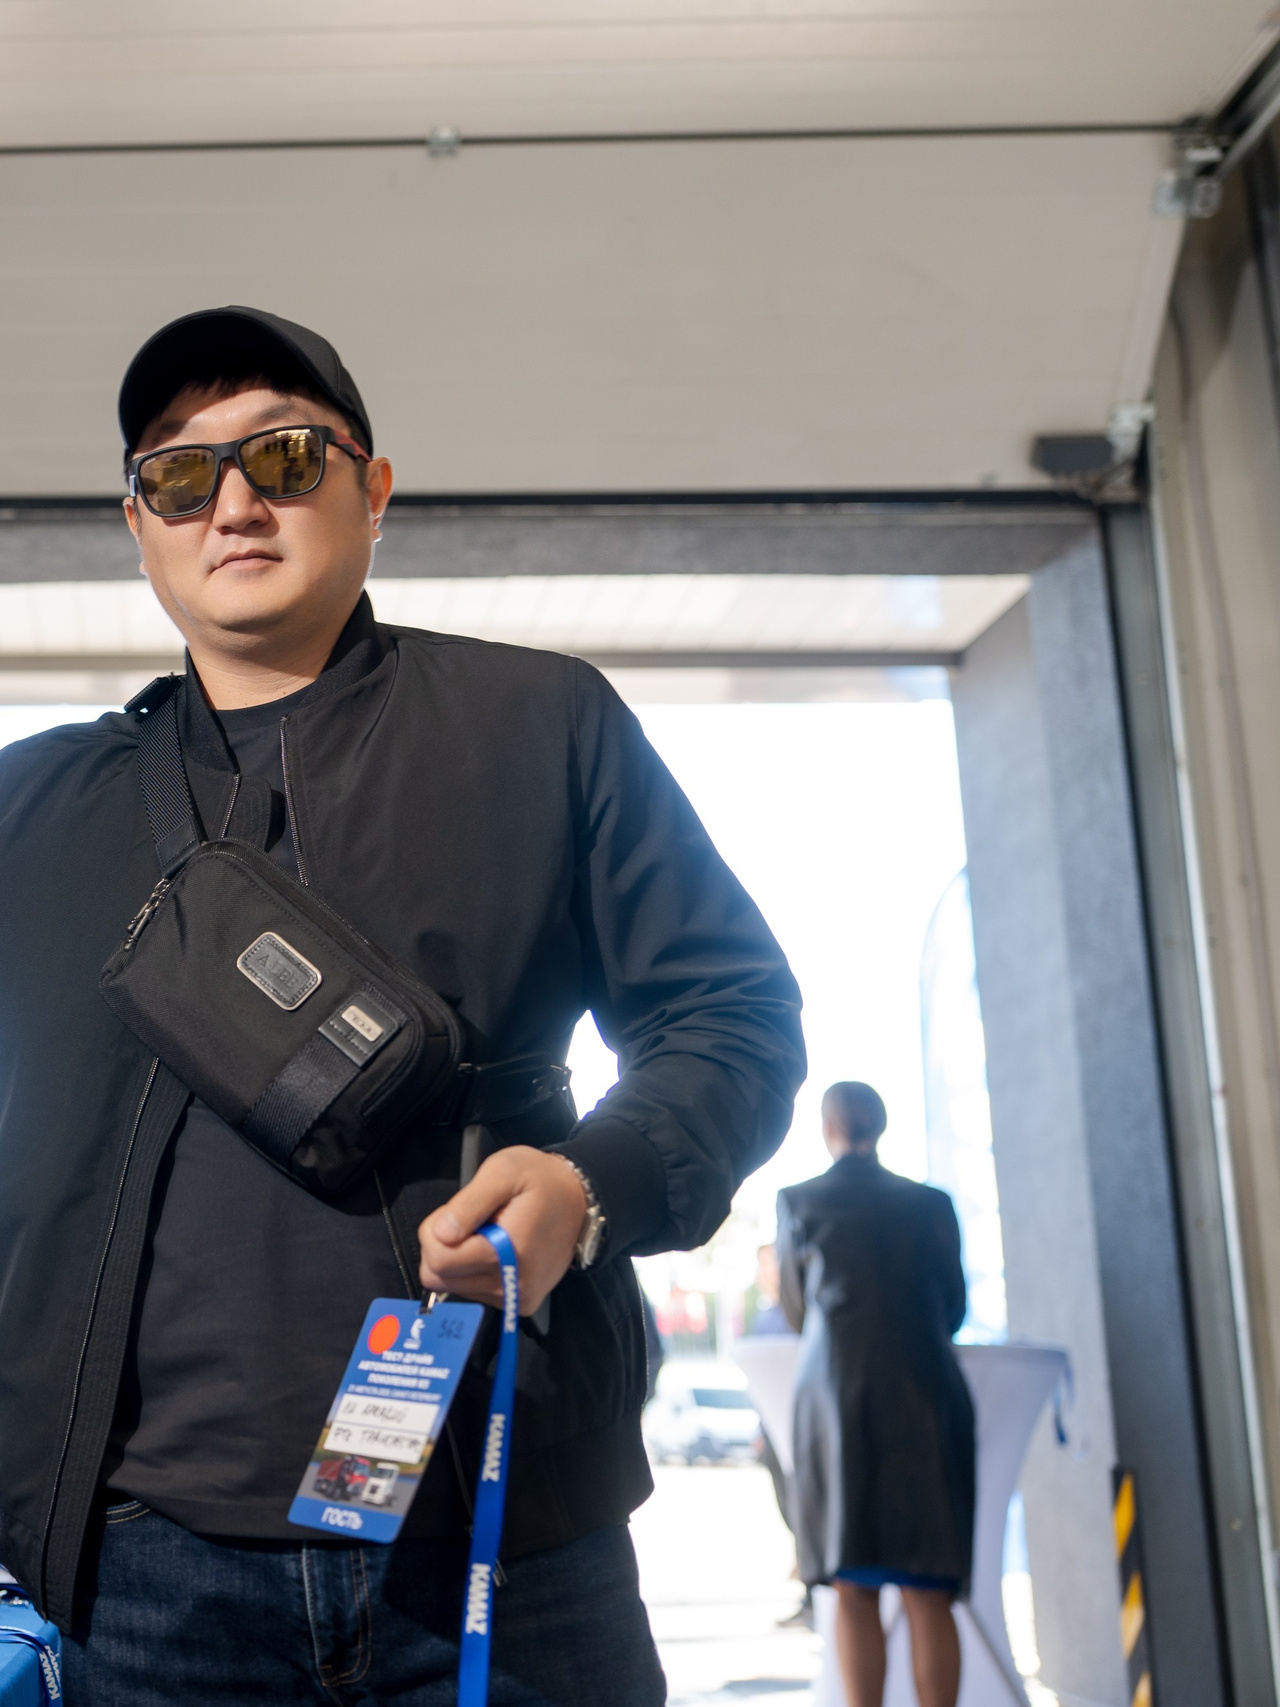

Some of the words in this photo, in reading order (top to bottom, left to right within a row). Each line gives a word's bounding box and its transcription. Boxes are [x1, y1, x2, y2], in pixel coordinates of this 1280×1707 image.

[501, 1264, 518, 1334] KAMAZ
[481, 1413, 506, 1483] KAMAZ
[321, 1506, 363, 1530] ГОСТЬ
[464, 1562, 491, 1636] KAMAZ
[39, 1651, 60, 1700] KAMAZ
